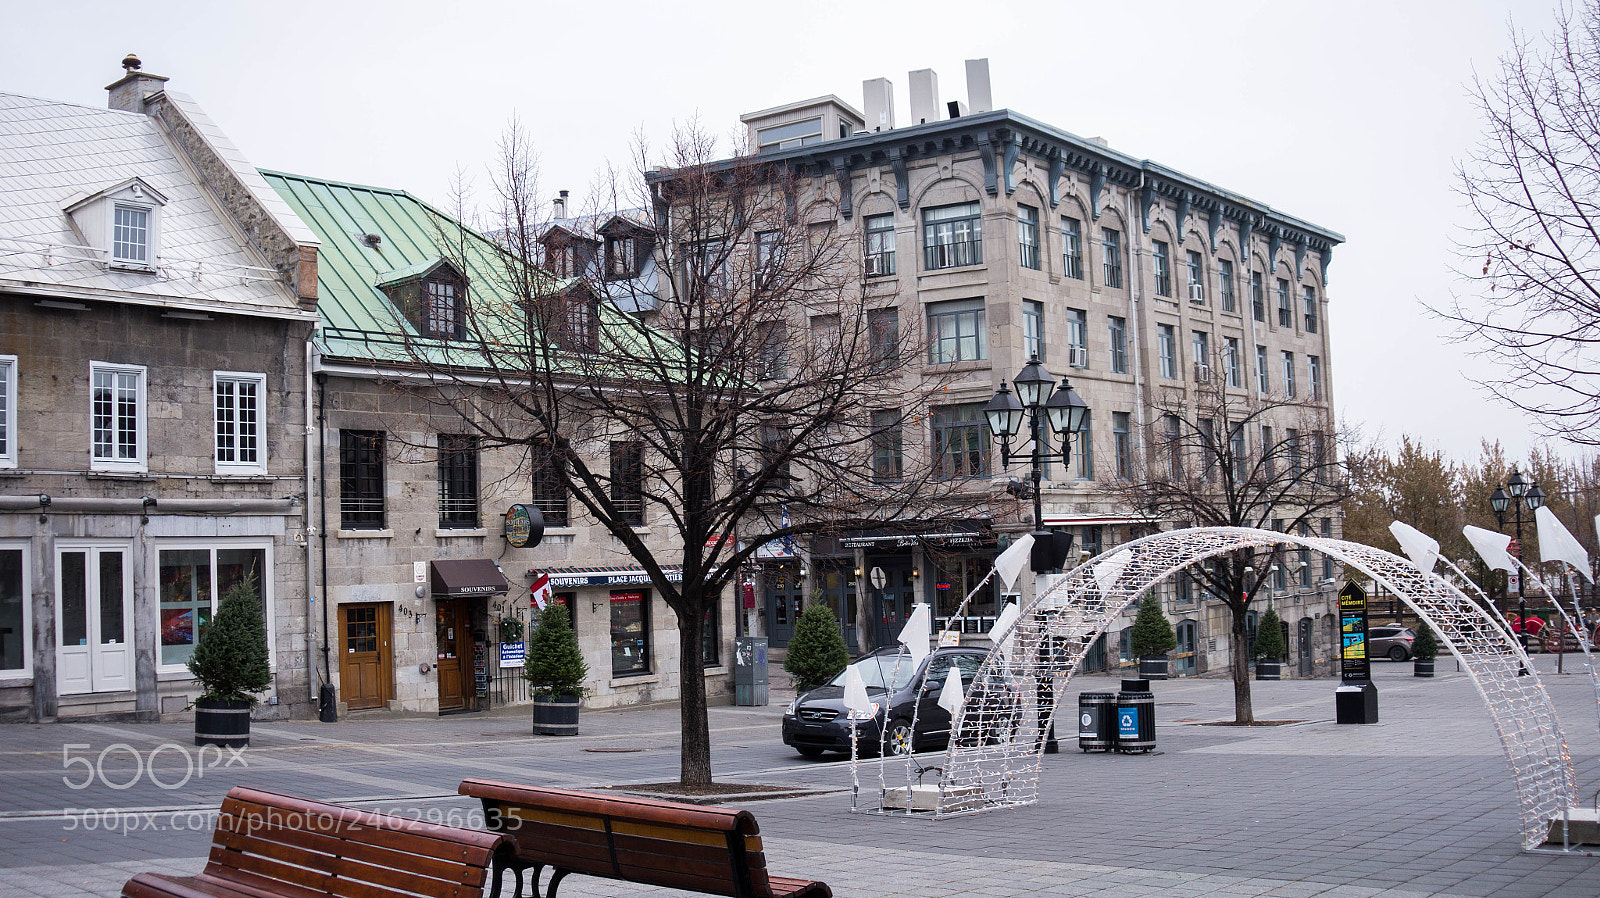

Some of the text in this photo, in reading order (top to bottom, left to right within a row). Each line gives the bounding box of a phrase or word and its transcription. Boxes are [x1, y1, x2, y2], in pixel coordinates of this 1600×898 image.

[550, 577, 589, 586] SOUVENIRS
[608, 576, 628, 584] PLACE
[398, 603, 413, 619] 403
[492, 601, 505, 614] 401
